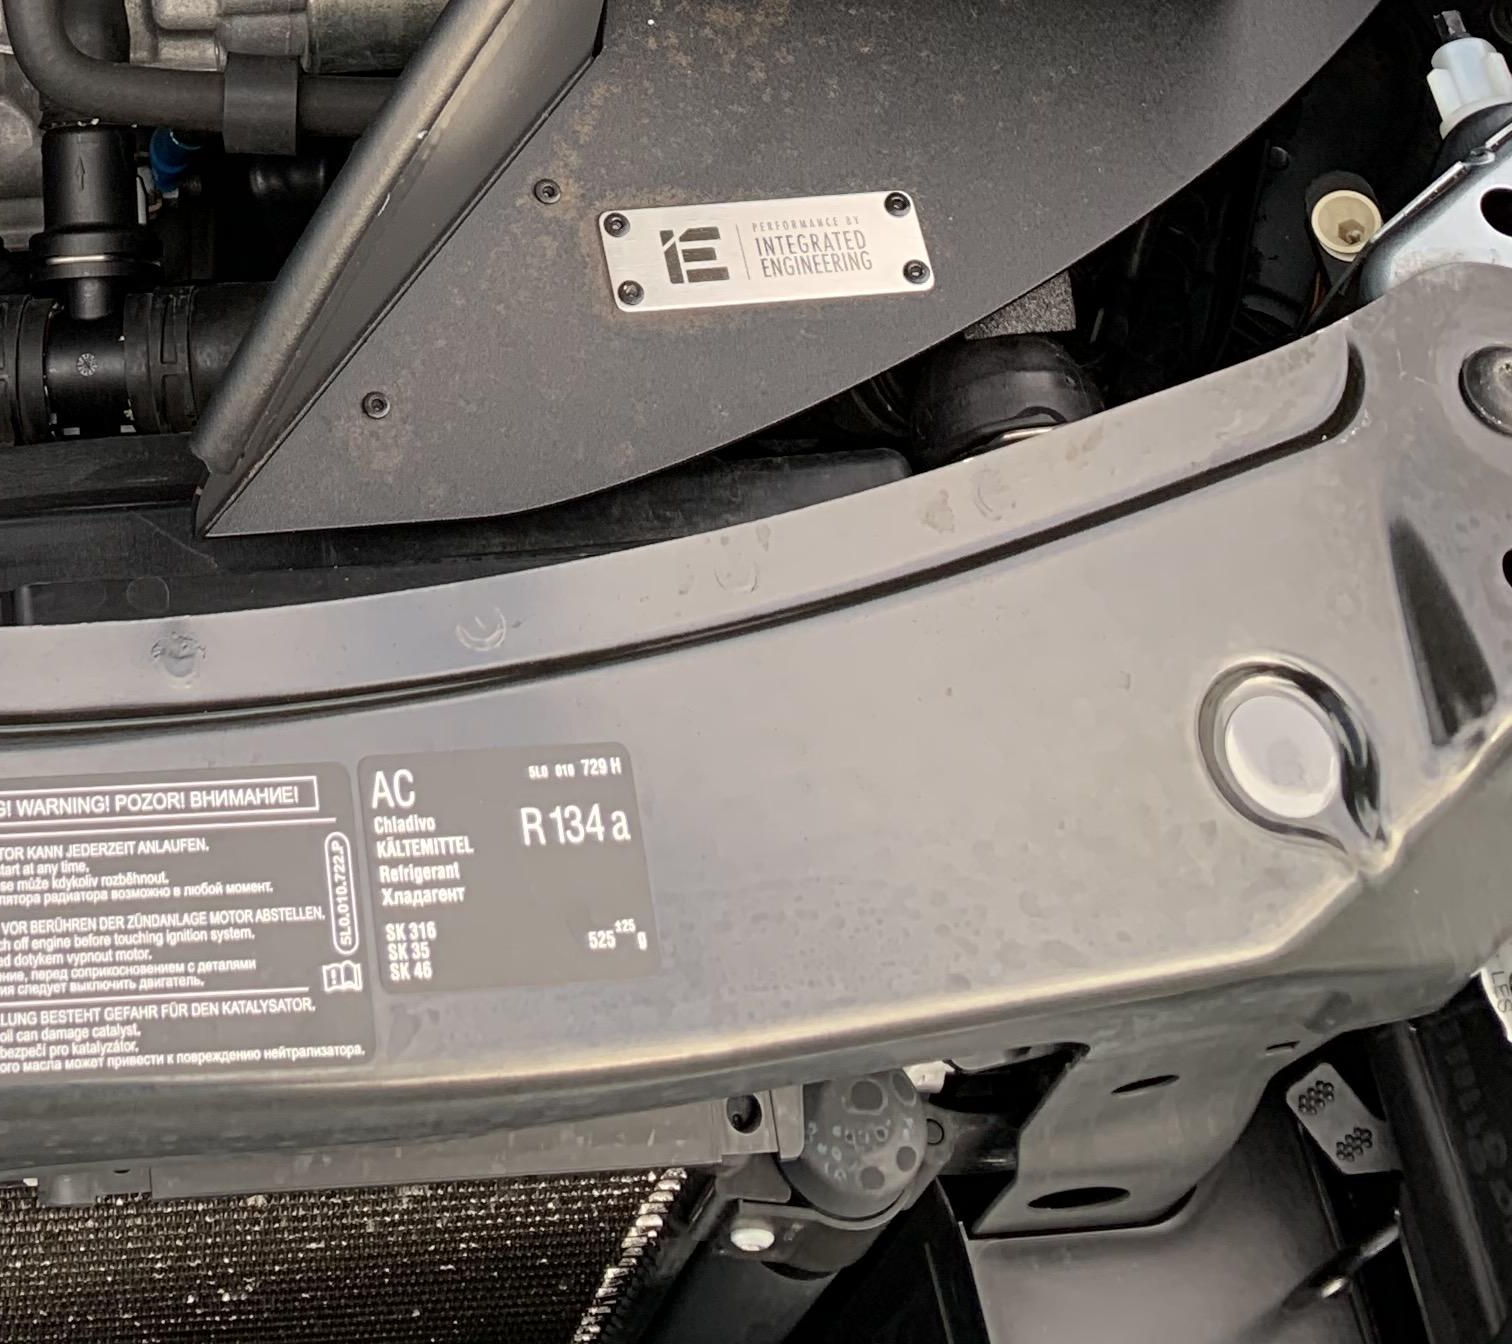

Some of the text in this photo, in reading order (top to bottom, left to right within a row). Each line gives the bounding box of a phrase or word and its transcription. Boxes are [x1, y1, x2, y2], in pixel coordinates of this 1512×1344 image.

[751, 215, 860, 233] PERFORMANCE BY
[754, 229, 867, 258] INTEGRATED
[759, 251, 874, 279] ENGINEERING
[555, 763, 575, 778] 010
[580, 758, 609, 777] 729
[610, 757, 622, 775] H
[371, 768, 416, 809] AC
[16, 795, 110, 817] WARNING!
[114, 791, 186, 812] POZOR!
[190, 785, 299, 808] ВНИМАНИЕ!
[374, 814, 436, 835] Chladivo
[520, 804, 632, 846] R 134 a
[26, 844, 63, 858] KANN
[66, 841, 136, 856] JEDERZEIT
[138, 837, 210, 852] ANLAUFEN.
[376, 836, 474, 859] KÄLTEMITTEL
[23, 862, 34, 875] at
[36, 864, 58, 877] any
[60, 859, 89, 873] time.
[379, 862, 461, 885] Refrigerant
[44, 892, 107, 905] радиатора
[111, 888, 170, 900] возможно
[174, 888, 181, 896] в
[184, 883, 223, 896] любой
[226, 883, 273, 894] момент.
[331, 840, 352, 946] 5L0.010.722.P
[381, 887, 465, 908] Хладагент
[1, 922, 27, 935] VOR
[30, 917, 96, 933] BERÜHREN
[99, 917, 125, 929] DER
[126, 912, 207, 928] ZÜNDANLAGE
[210, 910, 254, 924] MOTOR
[255, 906, 326, 921] ABSTELLEN.
[385, 921, 437, 942] SK 316
[14, 937, 29, 950] off
[31, 935, 71, 951] engine
[74, 933, 111, 947] before
[114, 930, 163, 947] touching
[166, 928, 207, 944] ignition
[210, 926, 255, 942] system.
[588, 930, 616, 949] 525
[14, 952, 64, 967] dotykem
[66, 949, 113, 965] vypnout
[116, 947, 152, 960] motor.
[388, 941, 430, 962] SK 35
[30, 970, 68, 983] перед
[71, 964, 184, 978] соприкосновением
[188, 963, 195, 972] с
[197, 960, 256, 972] деталями
[390, 961, 433, 982] SK 46
[17, 983, 66, 997] следует
[70, 979, 136, 992] выключить
[139, 976, 204, 988] двигатель.
[40, 1009, 101, 1024] BESTEHT
[104, 1006, 158, 1021] GEFAHR
[161, 1003, 189, 1018] FÜR
[192, 1003, 219, 1016] DEN
[222, 998, 316, 1015] KATALYSATOR.
[0, 1029, 13, 1041] oil
[16, 1031, 38, 1040] can
[41, 1025, 88, 1041] damage
[92, 1023, 141, 1038] catalyst.
[22, 1061, 62, 1072] масла
[64, 1059, 103, 1070] может
[107, 1056, 164, 1069] привести
[167, 1055, 174, 1064] к
[176, 1051, 261, 1065] повреждению
[264, 1043, 365, 1060] нейтрализатора.
